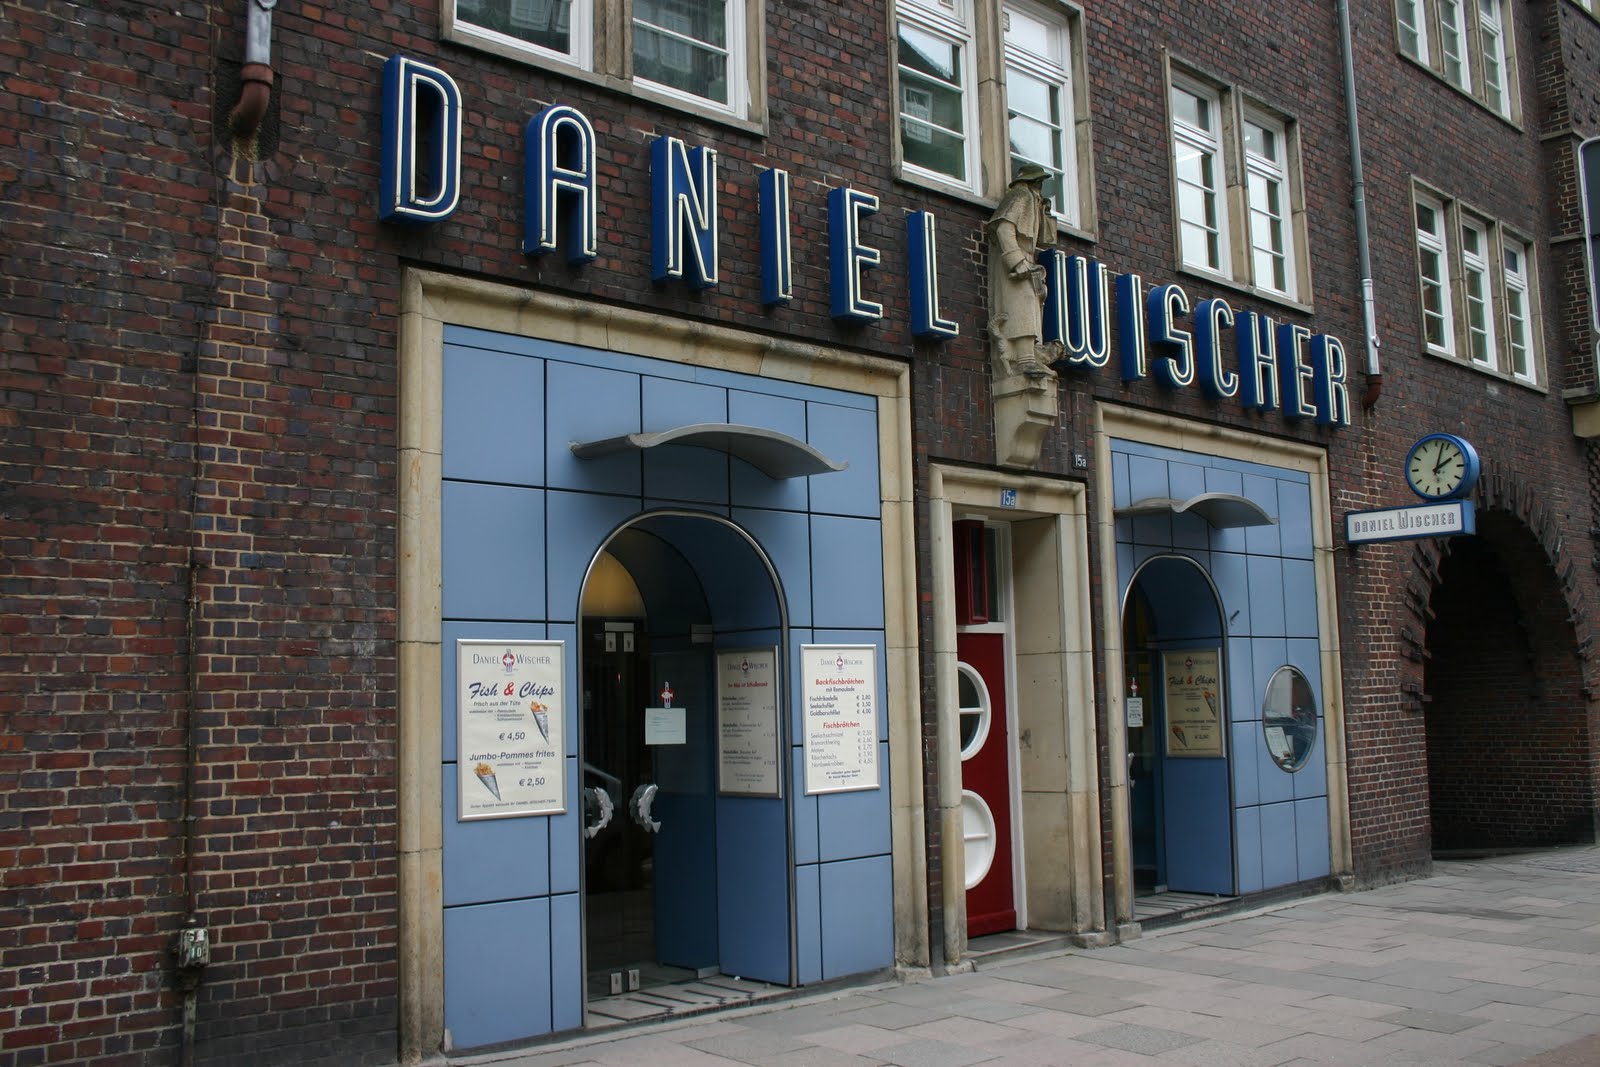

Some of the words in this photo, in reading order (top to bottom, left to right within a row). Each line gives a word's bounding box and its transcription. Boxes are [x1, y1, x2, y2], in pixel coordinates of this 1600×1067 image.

[380, 54, 960, 342] DANIEL
[1038, 248, 1352, 428] WISCHER
[1074, 454, 1087, 467] 15a
[1001, 489, 1015, 506] 15a
[1354, 518, 1395, 533] DANIEL
[1397, 510, 1455, 529] WISCHER
[472, 653, 501, 665] DANIEL
[515, 653, 551, 665] WISCHER
[1195, 675, 1216, 686] Chips
[468, 681, 499, 699] Fish
[503, 681, 515, 696] &
[518, 681, 555, 699] Chips
[499, 732, 506, 741] €
[507, 732, 526, 742] 4,50
[469, 752, 534, 761] Jumbo-Pommes
[535, 749, 556, 758] frites
[518, 778, 525, 787] €
[526, 777, 545, 788] 2,50
